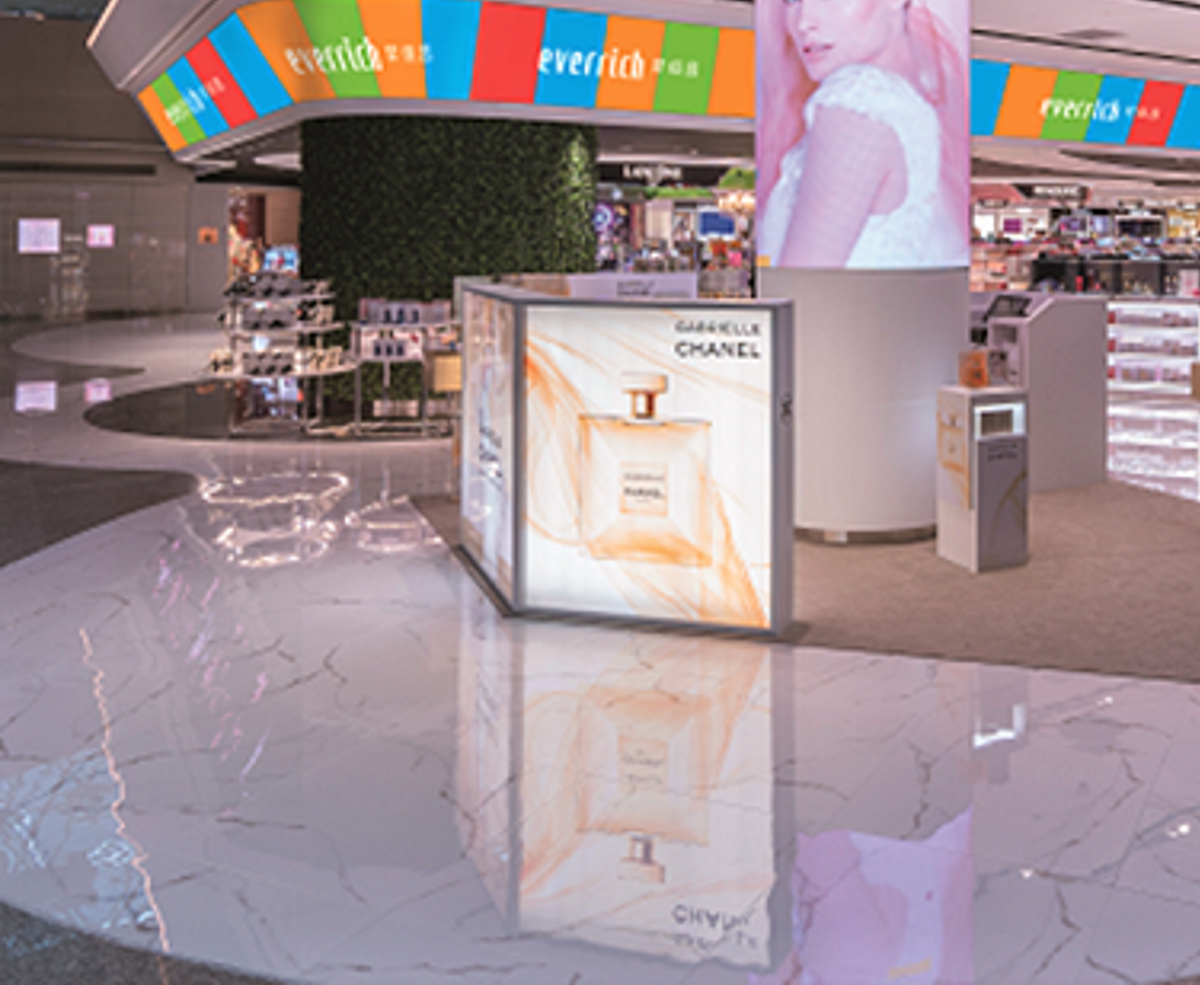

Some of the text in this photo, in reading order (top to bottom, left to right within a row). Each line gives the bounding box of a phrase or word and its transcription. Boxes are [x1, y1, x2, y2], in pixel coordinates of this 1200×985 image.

[284, 36, 385, 75] everrich
[538, 48, 645, 80] everrich
[674, 341, 761, 359] CHANEL
